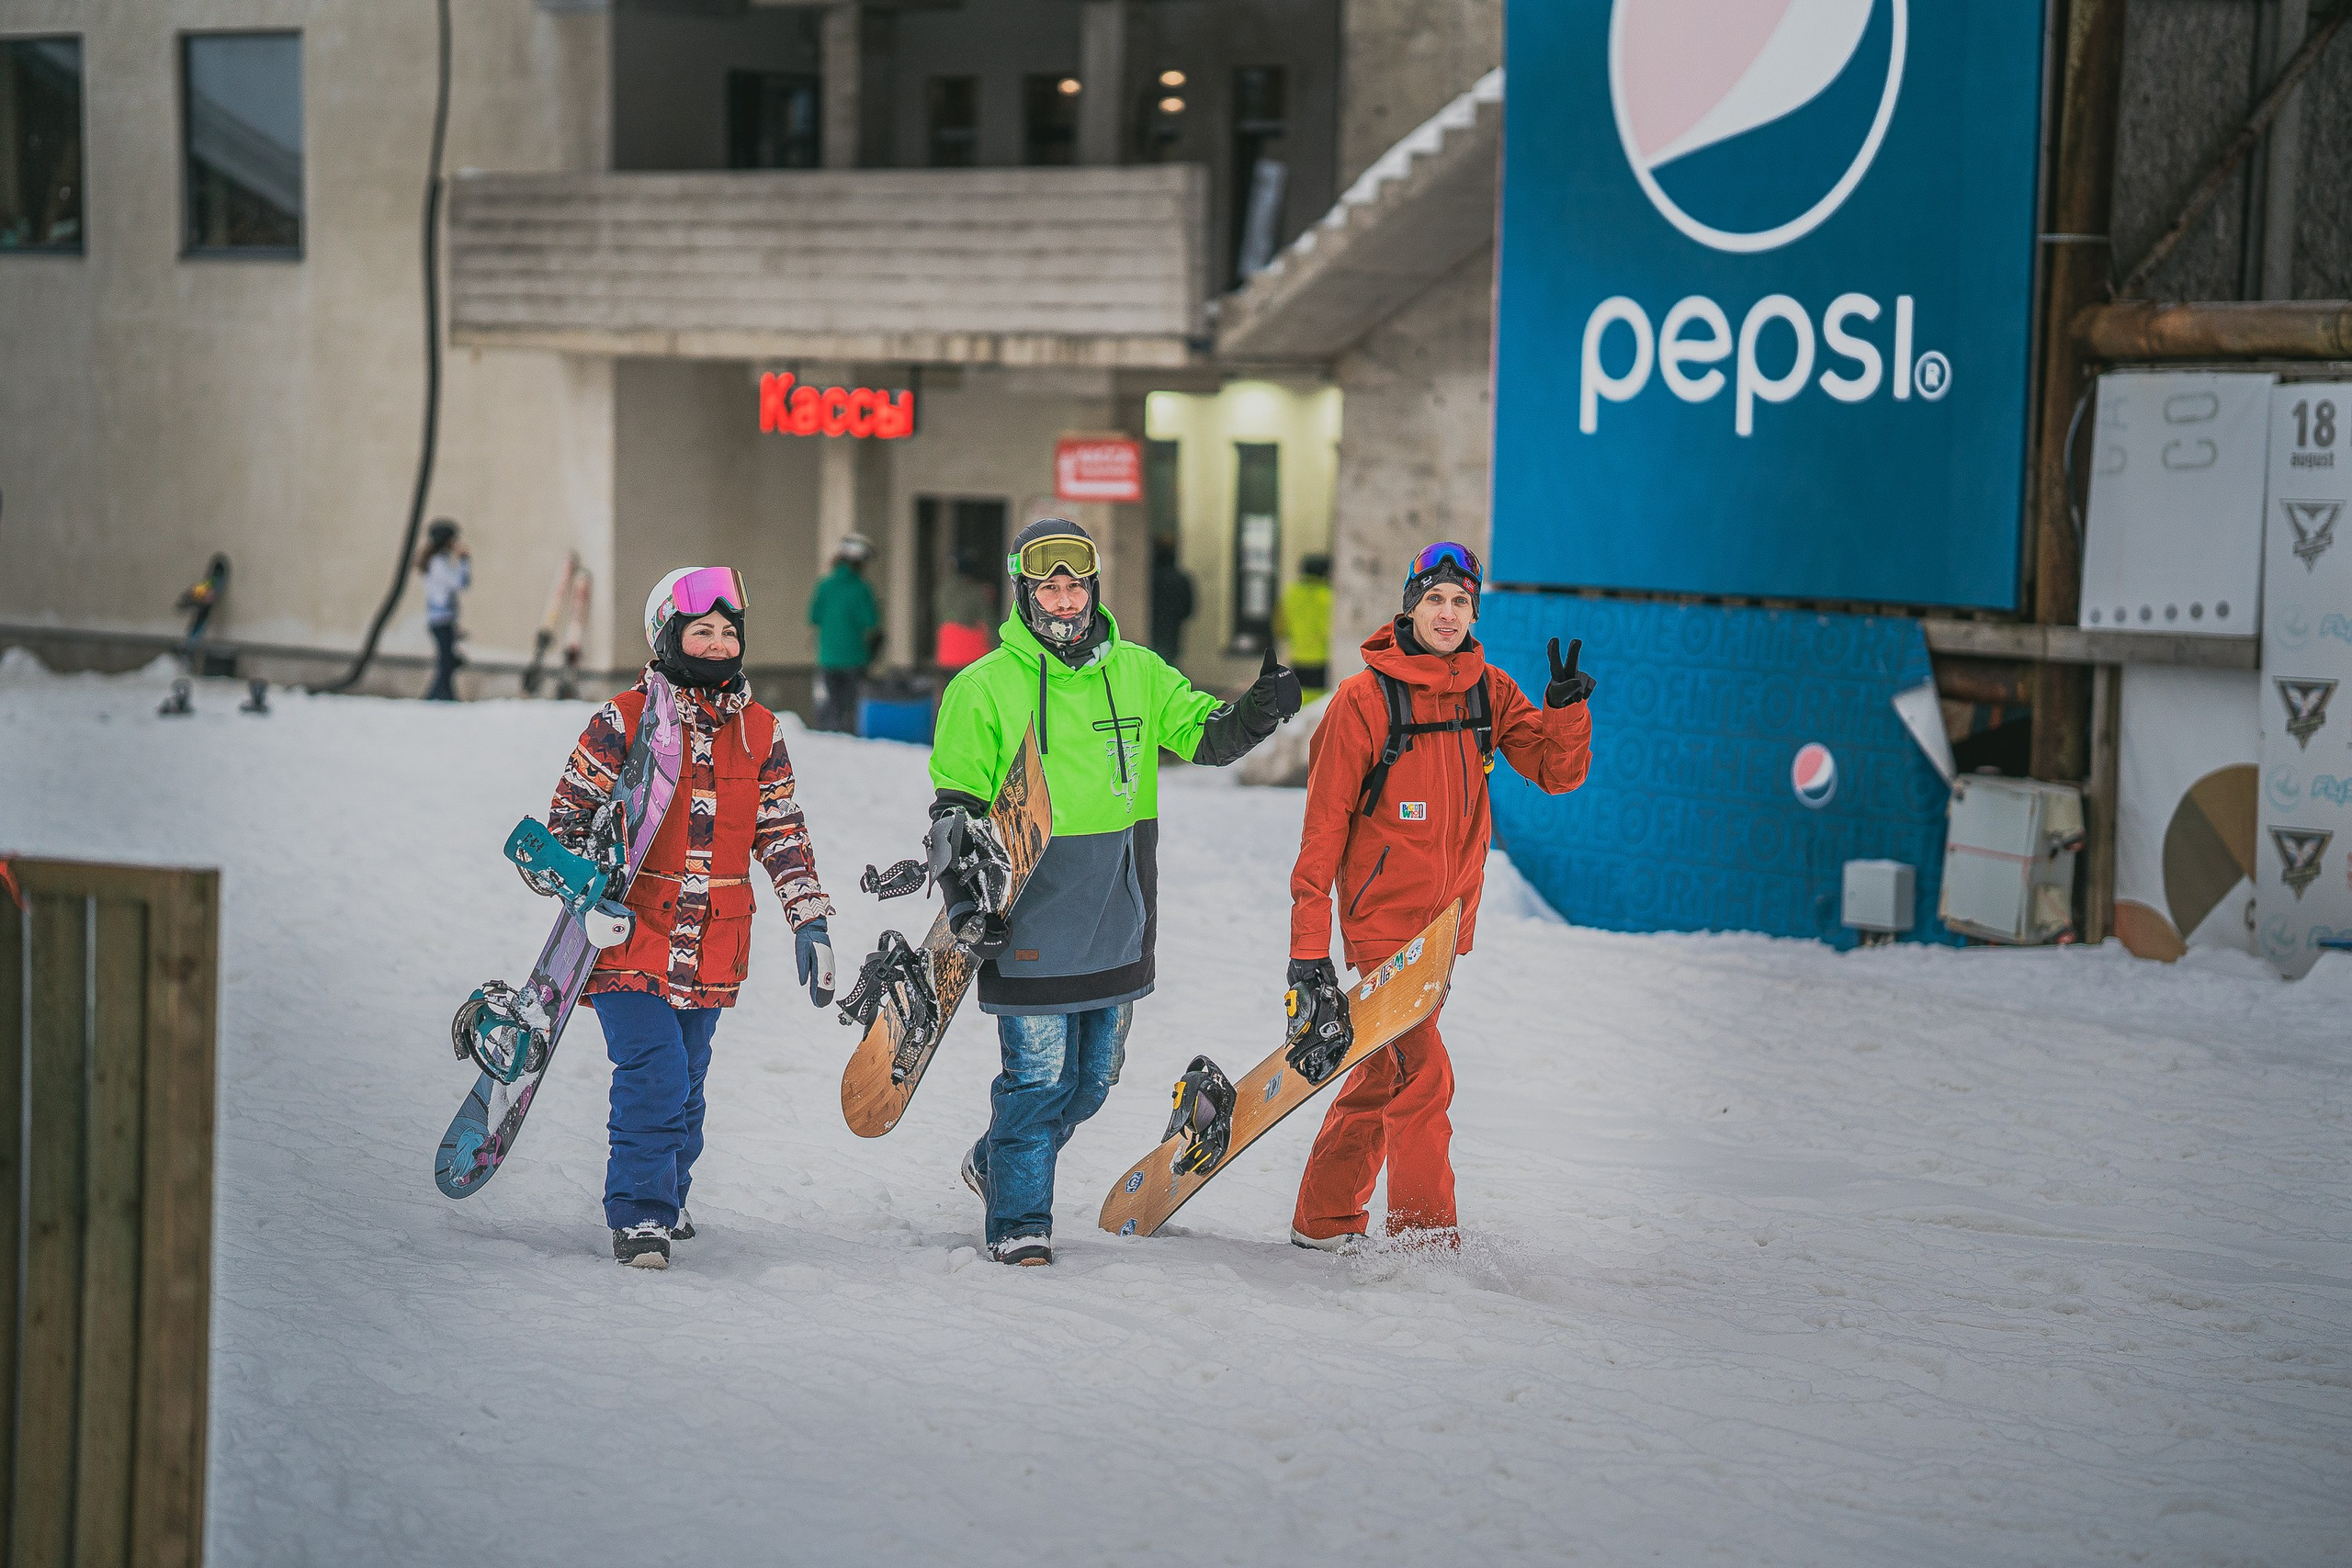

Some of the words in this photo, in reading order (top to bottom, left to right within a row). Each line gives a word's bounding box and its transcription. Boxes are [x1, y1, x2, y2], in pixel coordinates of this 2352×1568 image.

[759, 371, 915, 439] Кассы
[2291, 399, 2336, 447] 18
[2290, 450, 2335, 469] august
